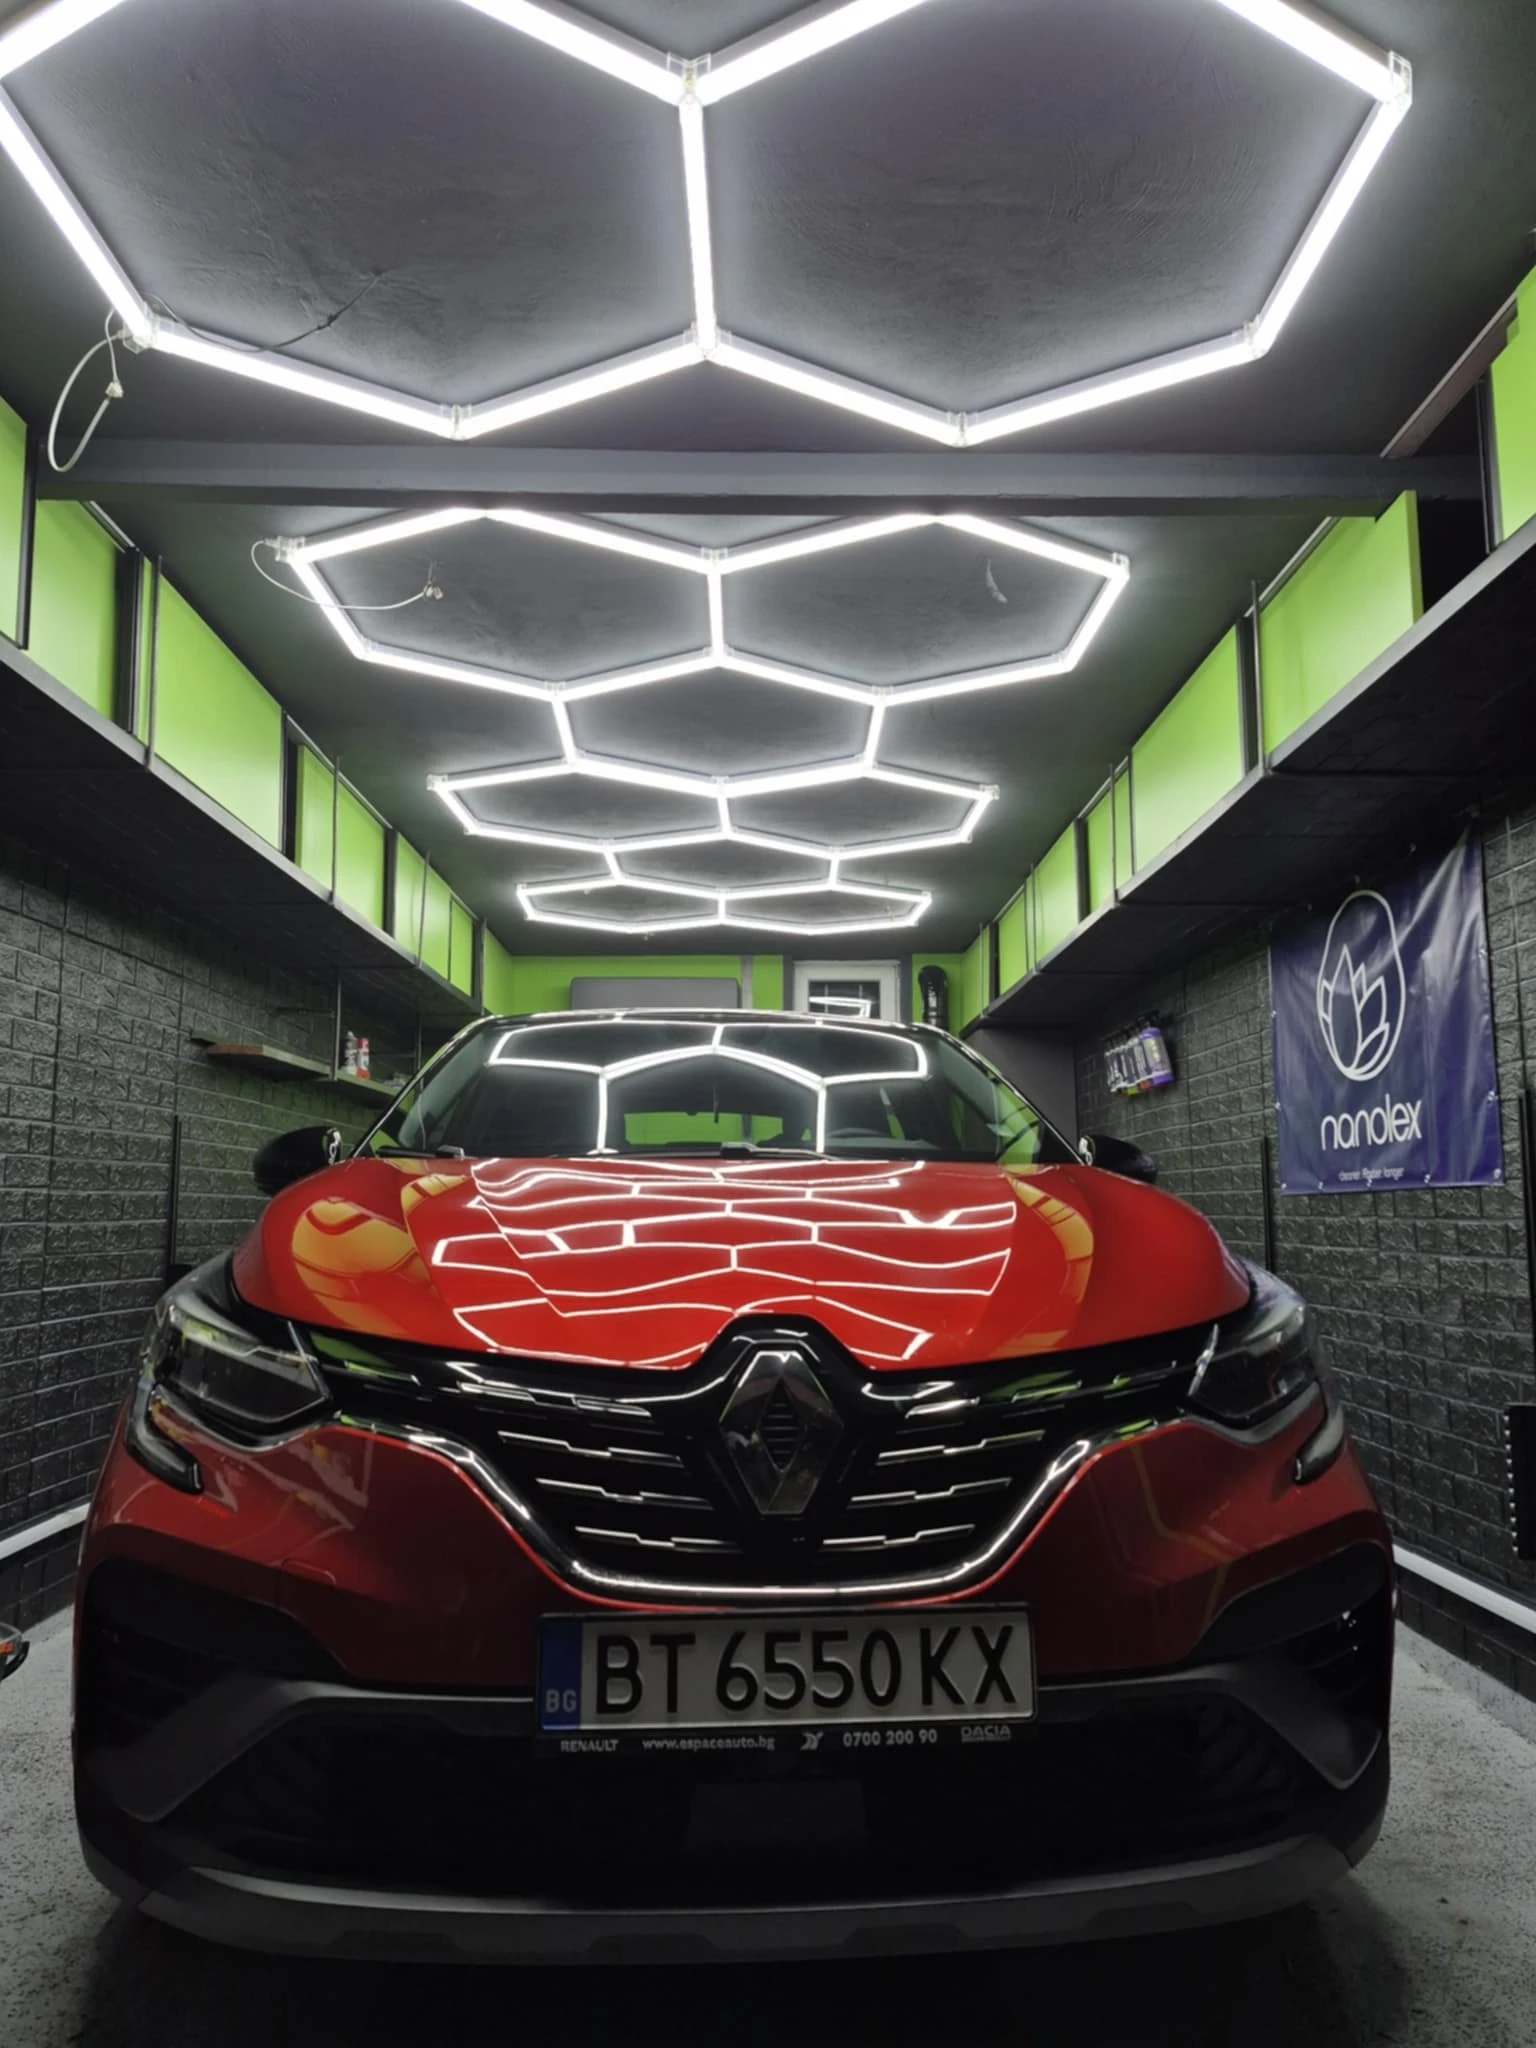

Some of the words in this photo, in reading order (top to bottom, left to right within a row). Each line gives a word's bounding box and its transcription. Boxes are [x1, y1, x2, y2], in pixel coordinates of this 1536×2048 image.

[1321, 1093, 1422, 1151] nanolex
[596, 1633, 696, 1716] BT
[715, 1629, 902, 1712] 6550
[920, 1625, 1017, 1706] KX
[545, 1689, 577, 1713] BG
[560, 1739, 618, 1752] RENAULT
[642, 1735, 776, 1751] www.espaceauto.bg
[842, 1731, 881, 1747] 0700
[885, 1730, 914, 1746] 200
[918, 1728, 938, 1744] 90
[960, 1725, 1012, 1737] DACIA
